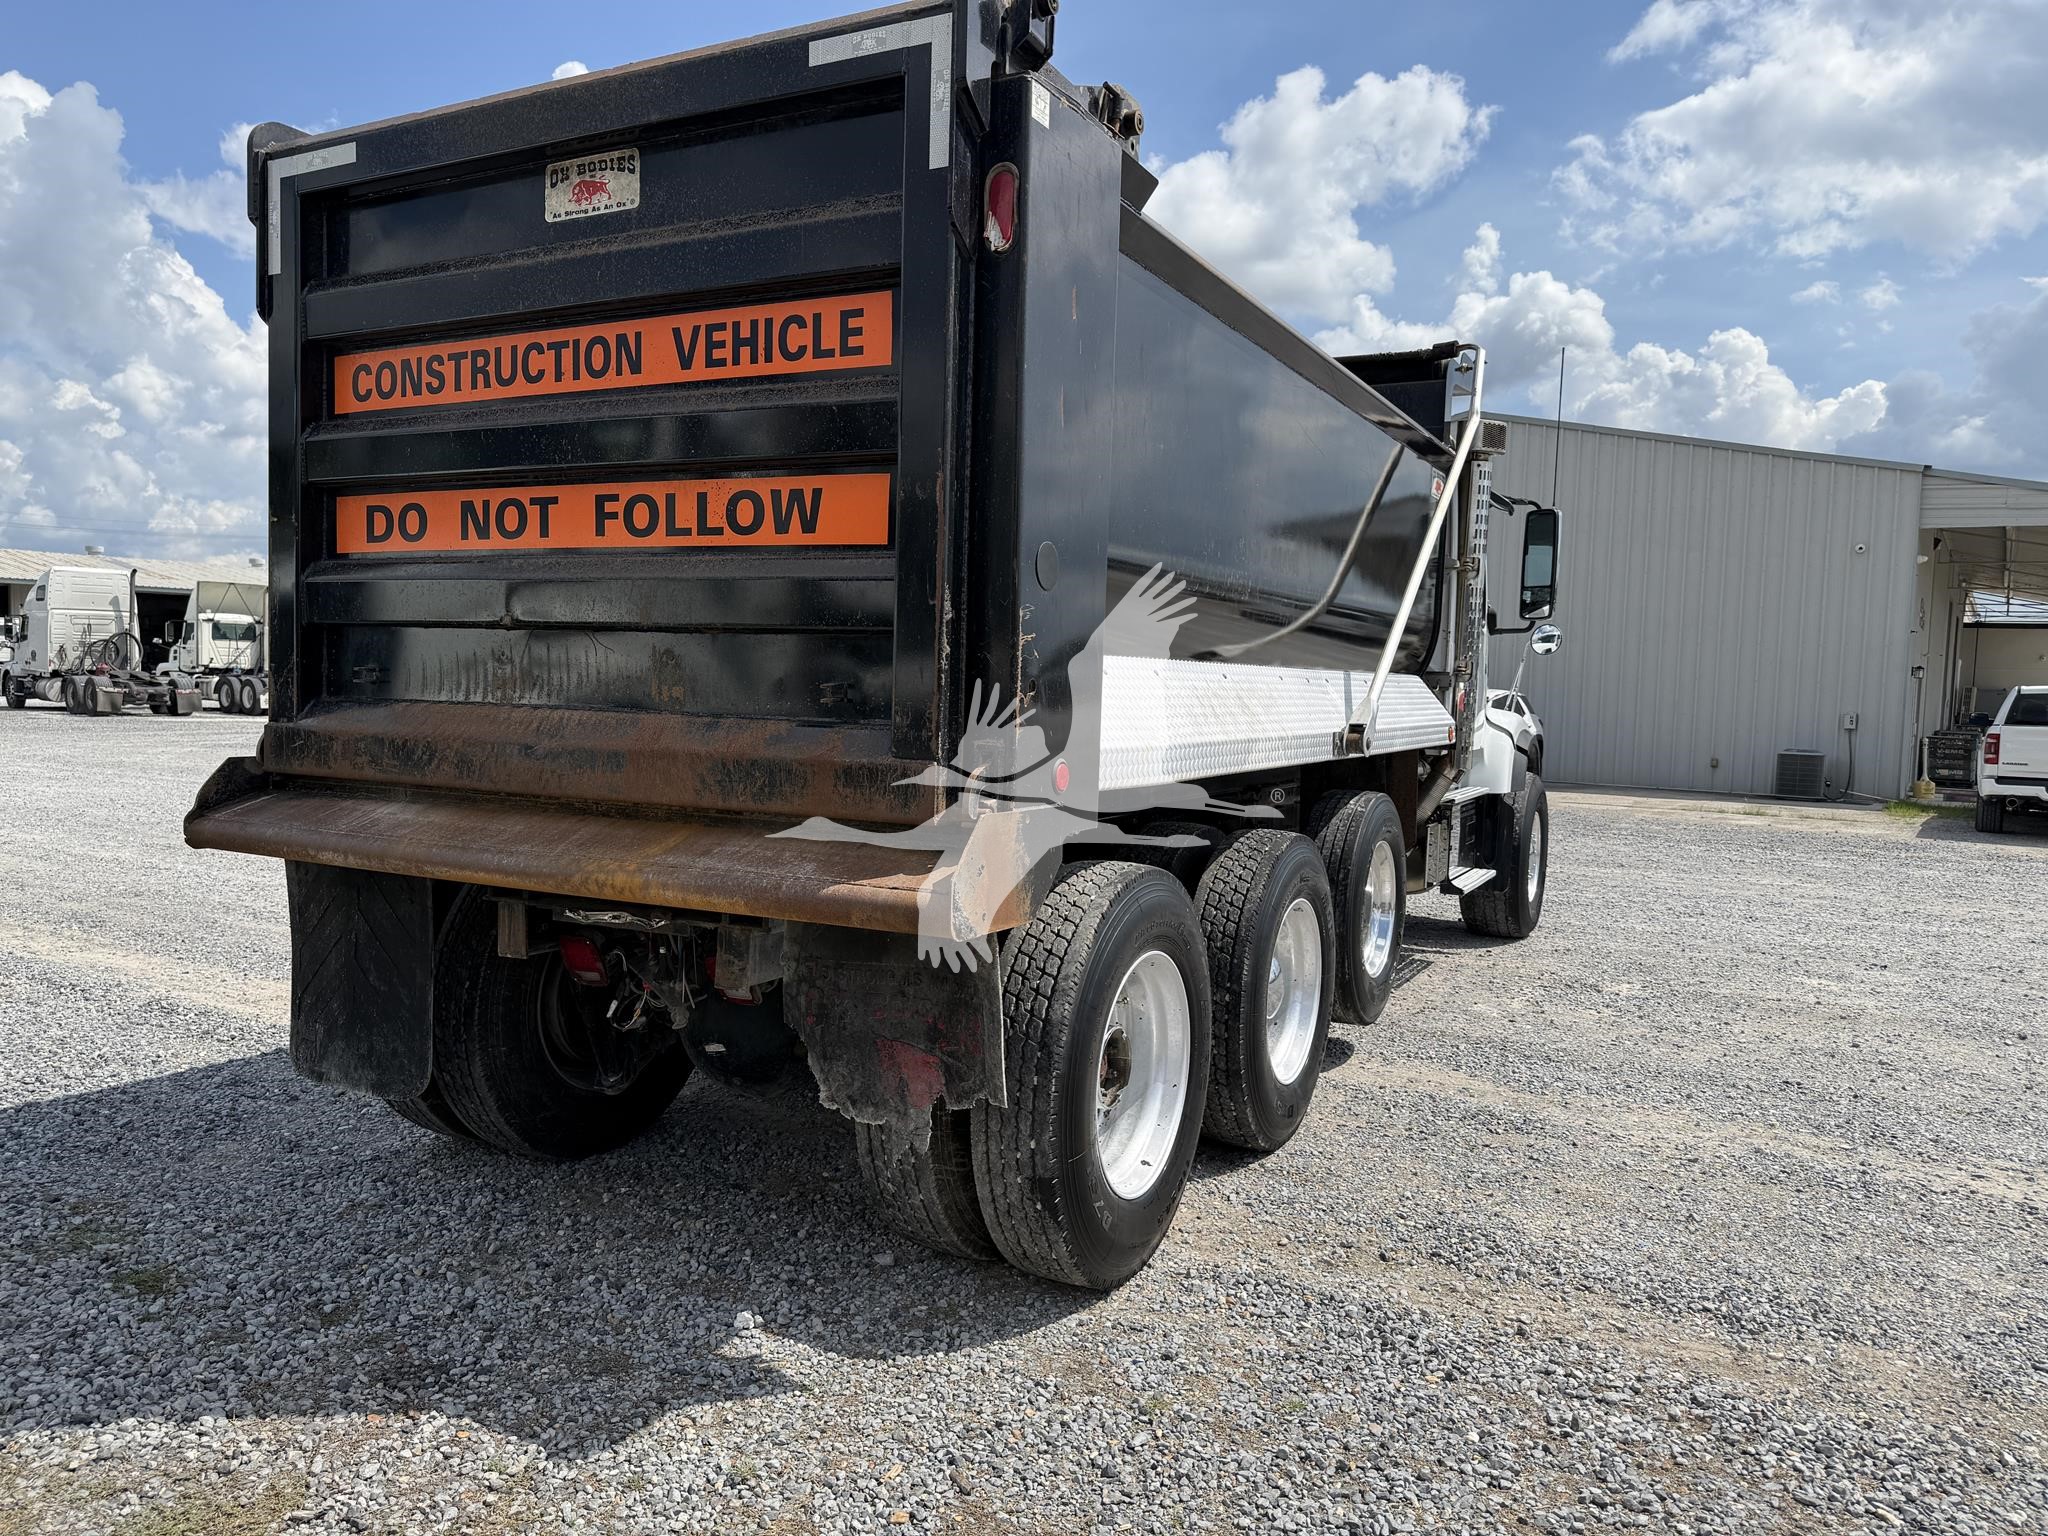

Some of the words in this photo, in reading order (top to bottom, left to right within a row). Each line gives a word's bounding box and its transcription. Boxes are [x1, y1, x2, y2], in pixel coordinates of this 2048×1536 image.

[550, 166, 570, 189] OX
[576, 154, 636, 175] BODIES
[564, 208, 589, 217] Strong
[591, 205, 601, 213] As
[352, 330, 644, 403] CONSTRUCTION
[672, 307, 865, 372] VEHICLE
[365, 502, 428, 544] DO
[460, 496, 559, 541] NOT
[595, 487, 823, 539] FOLLOW
